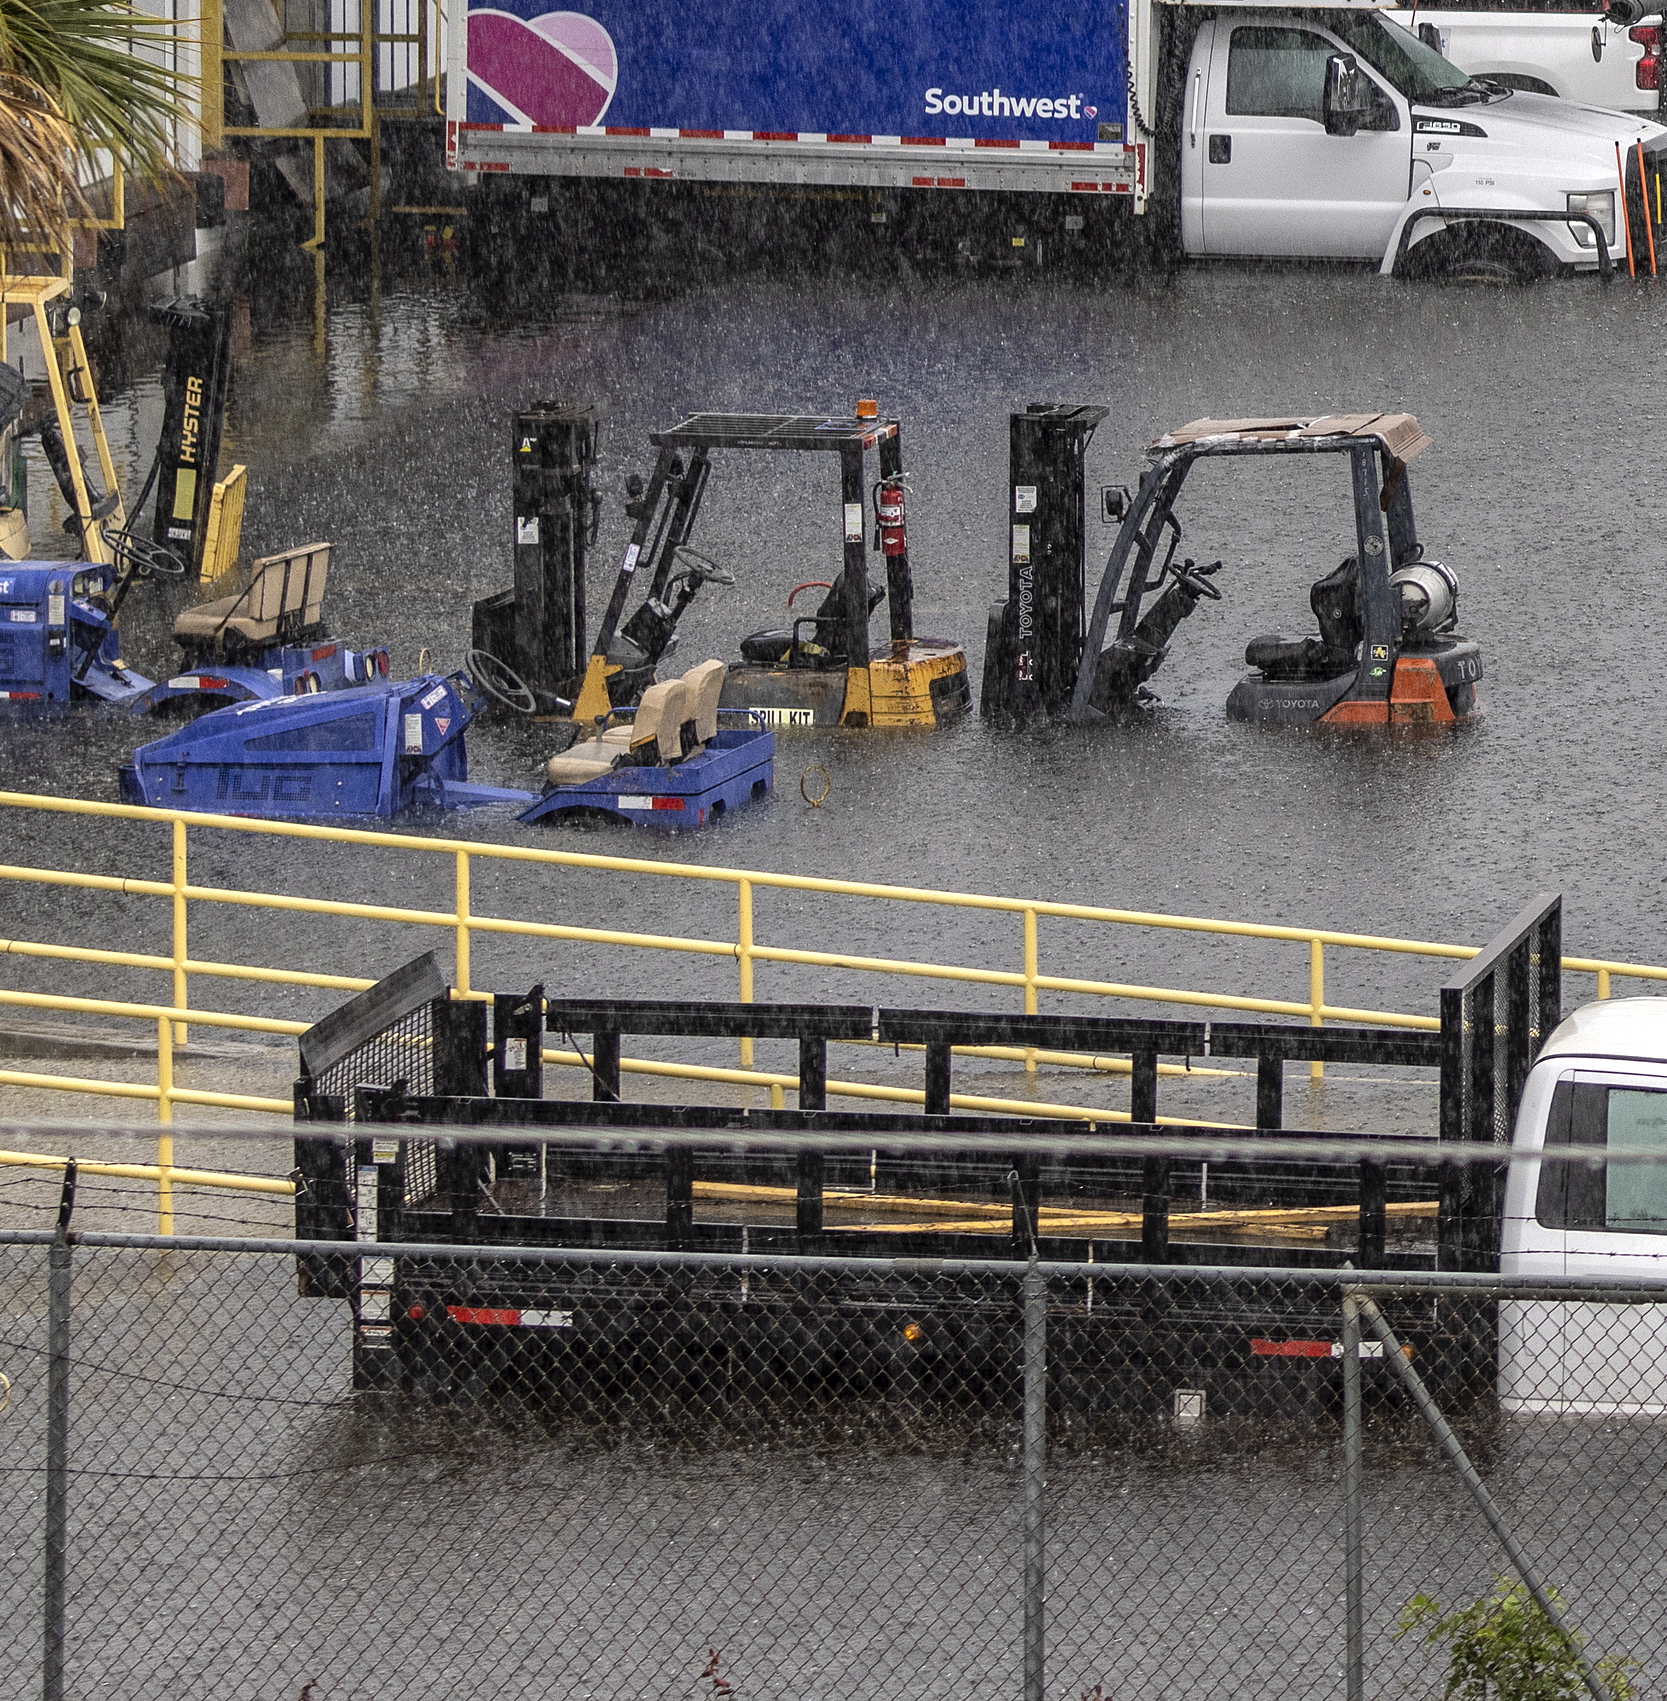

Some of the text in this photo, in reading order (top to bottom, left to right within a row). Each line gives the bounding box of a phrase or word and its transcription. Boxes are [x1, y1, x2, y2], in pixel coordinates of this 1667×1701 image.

[925, 88, 1083, 120] Southwest
[180, 375, 203, 463] HYSTER
[1019, 566, 1033, 639] TOYOTA
[790, 711, 810, 724] KIT
[1276, 699, 1319, 708] TOYOTA
